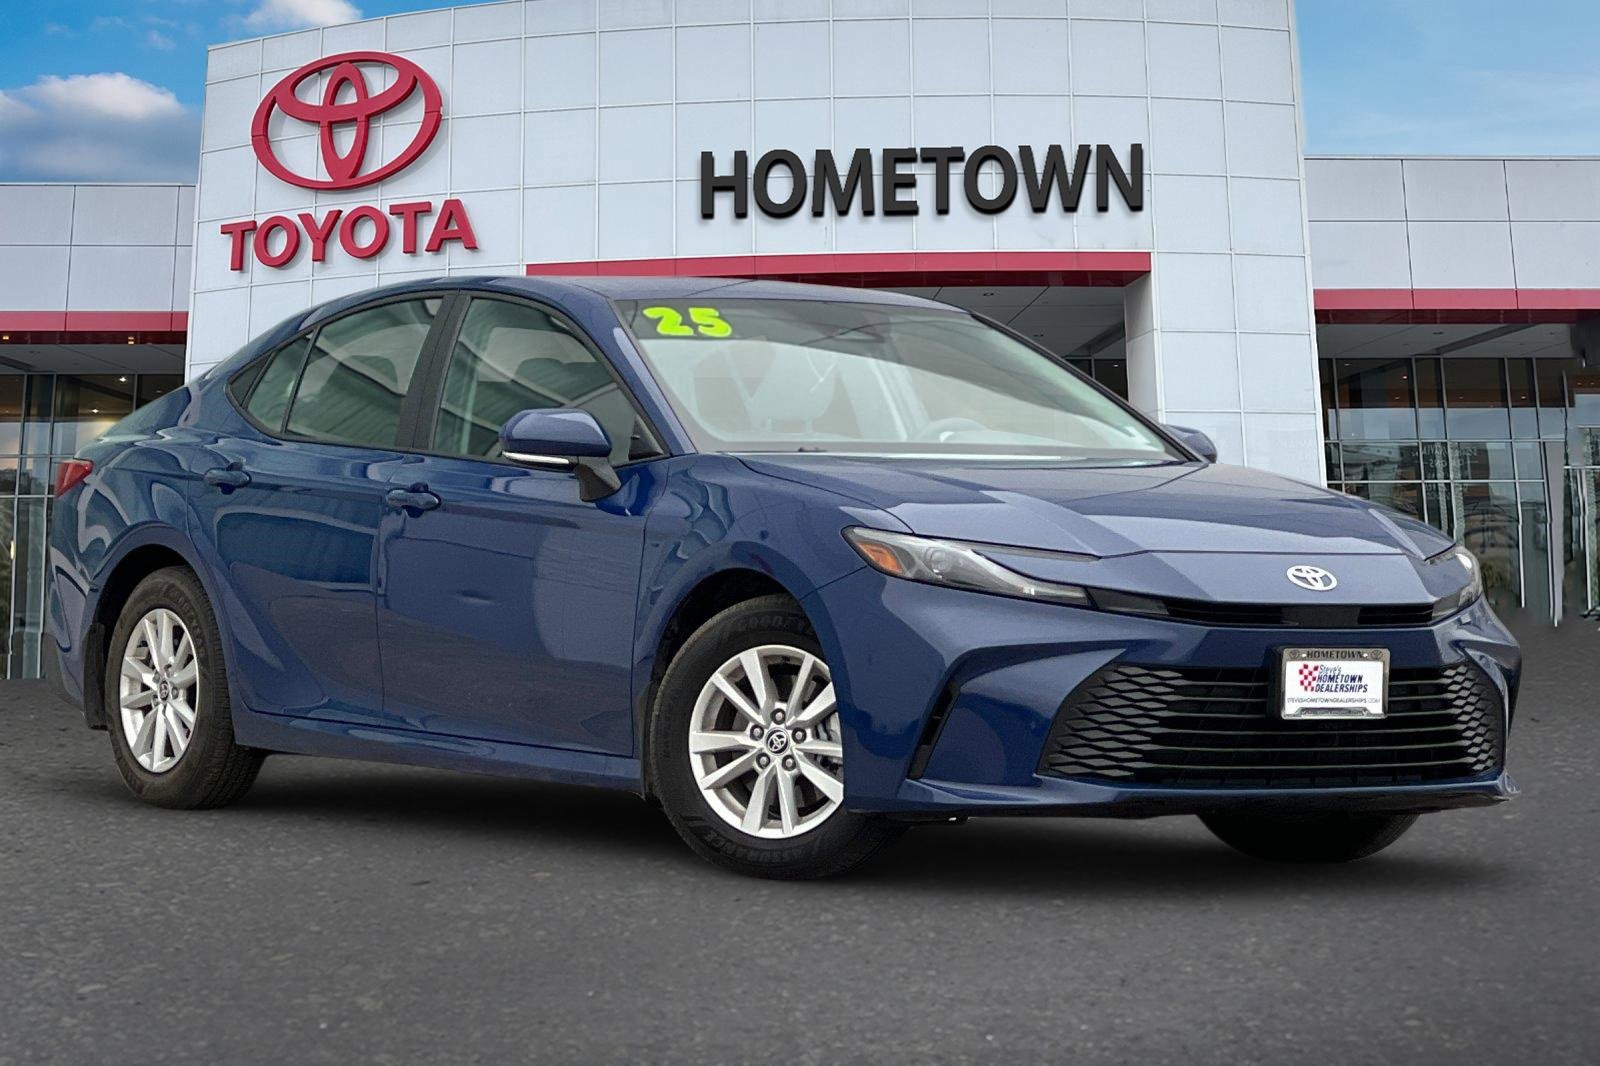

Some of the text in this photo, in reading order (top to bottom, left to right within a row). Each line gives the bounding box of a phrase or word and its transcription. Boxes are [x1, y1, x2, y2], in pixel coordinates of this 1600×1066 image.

[701, 143, 1144, 219] HOMETOWN
[220, 198, 479, 272] TOYOTA
[642, 306, 732, 338] 25
[1306, 650, 1363, 660] HOMETOWN
[1319, 664, 1342, 675] Steve's
[1317, 674, 1363, 684] HOMETOWN
[1315, 683, 1369, 693] DEALERSHIPS
